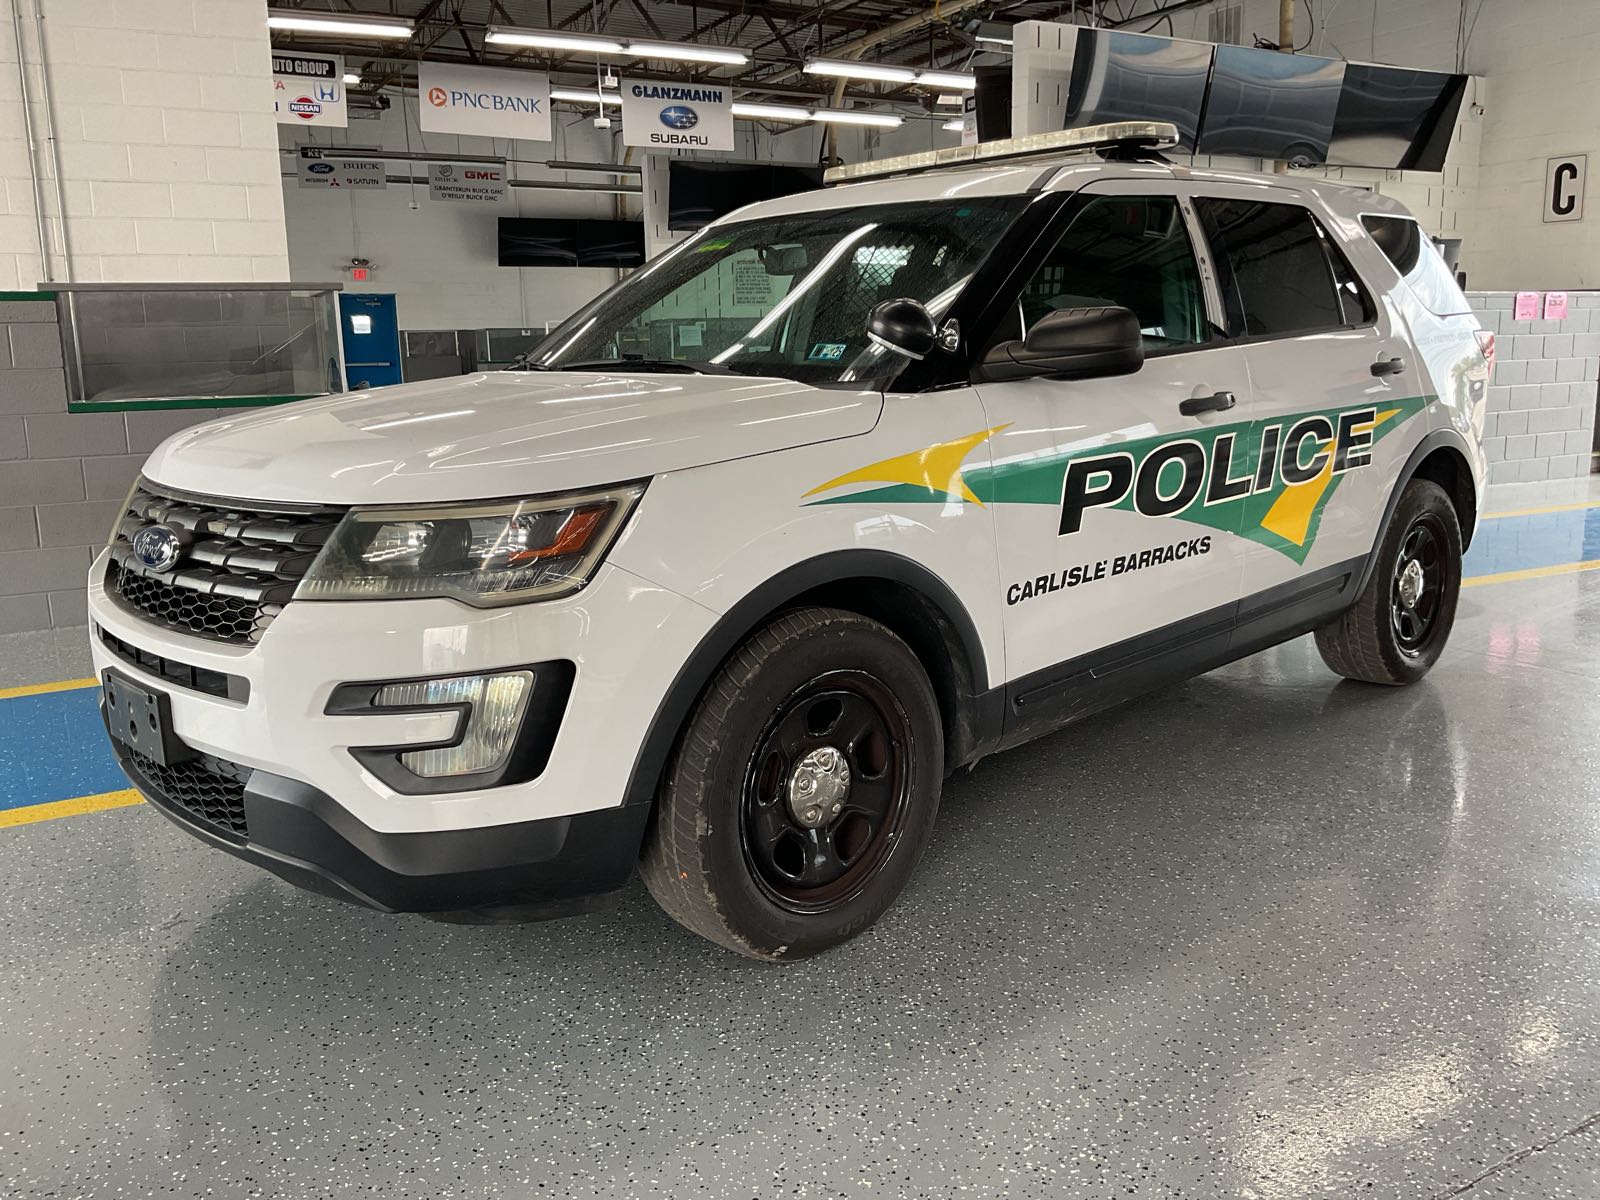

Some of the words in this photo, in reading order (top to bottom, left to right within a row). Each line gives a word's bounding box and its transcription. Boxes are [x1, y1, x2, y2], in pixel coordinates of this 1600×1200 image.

[273, 59, 293, 73] UTO
[294, 60, 329, 75] GROUP
[631, 85, 723, 103] GLANZMANN
[291, 103, 320, 113] NISSAN
[650, 133, 708, 146] SUBARU
[343, 162, 379, 170] BUICK
[464, 170, 501, 181] GMC
[441, 192, 465, 200] O'REILLY
[1552, 162, 1578, 216] C
[1057, 407, 1377, 537] POLICE
[137, 531, 163, 560] Ford
[1006, 560, 1109, 607] CARLISLE
[1111, 535, 1212, 582] BARRACKS
